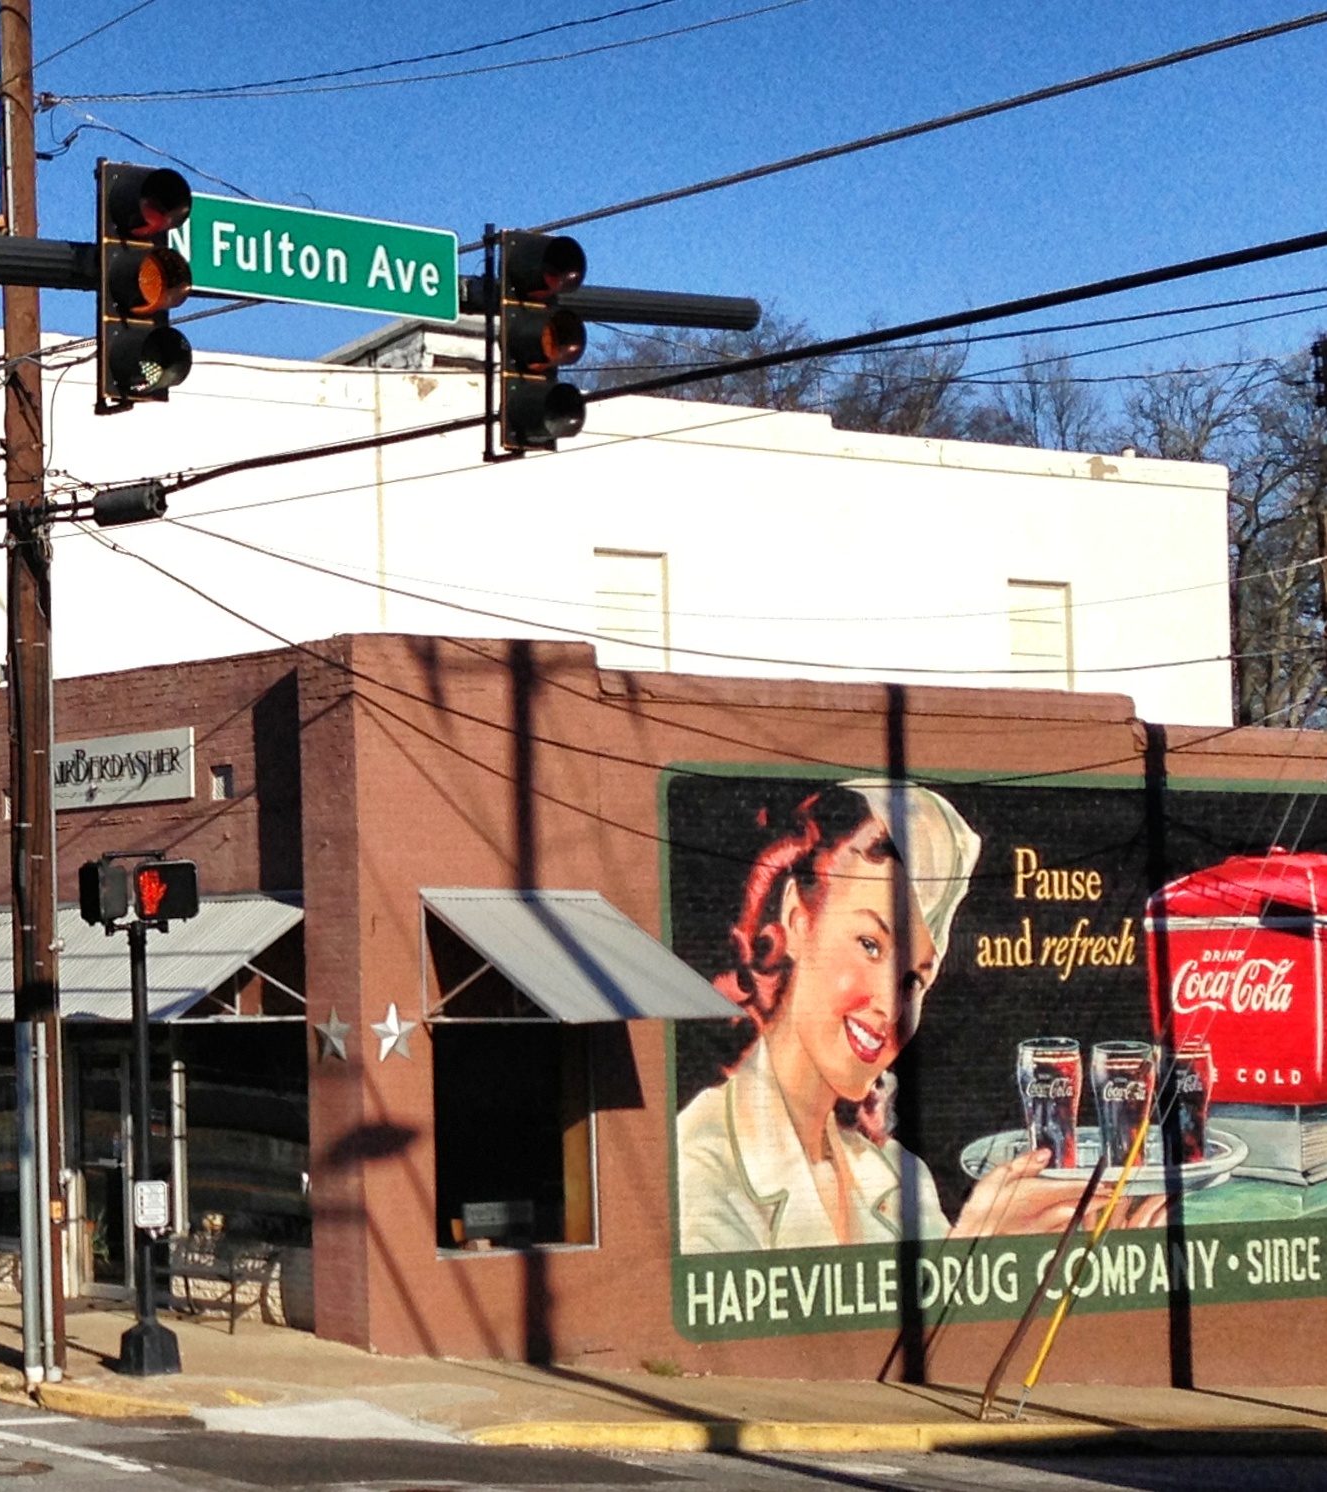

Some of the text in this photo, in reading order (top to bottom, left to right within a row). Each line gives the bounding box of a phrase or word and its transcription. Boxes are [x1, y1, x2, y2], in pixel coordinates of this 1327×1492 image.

[168, 218, 440, 297] N Fulton Ave
[1014, 847, 1103, 901] Pause
[976, 917, 1136, 981] and refresh
[1201, 949, 1246, 963] DRINK
[1171, 958, 1296, 1014] Coca-Cola
[1026, 1077, 1074, 1099] Coca-Cola
[1102, 1081, 1147, 1102] Coca-Cla
[1237, 1067, 1302, 1085] COLD
[687, 1236, 1322, 1327] HAPEVILLE DRUG COMPANY SINCE
